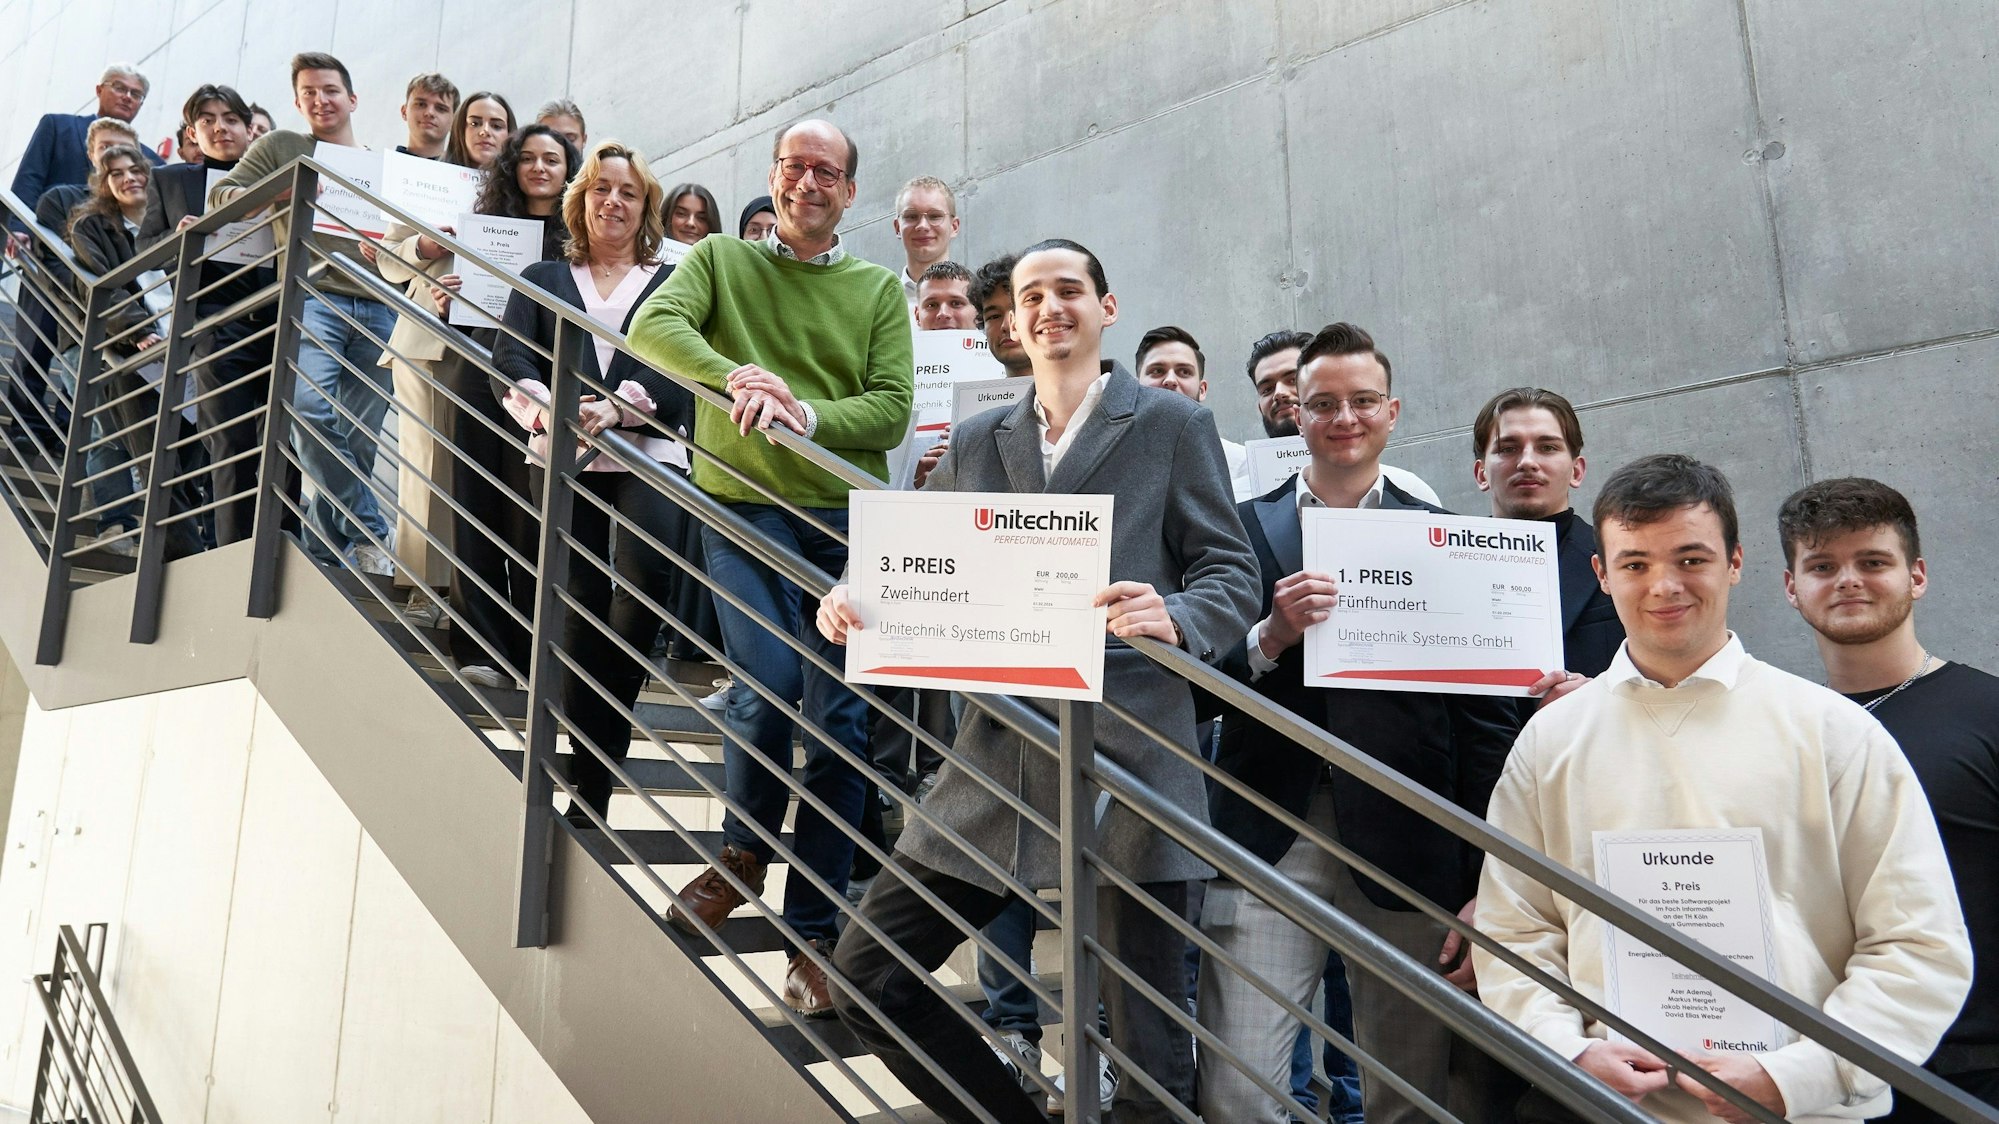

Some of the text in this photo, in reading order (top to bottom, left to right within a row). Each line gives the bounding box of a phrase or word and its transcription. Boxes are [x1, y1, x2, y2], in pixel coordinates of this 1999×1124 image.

[416, 181, 450, 194] PREIS
[482, 226, 519, 236] Urkunde
[916, 364, 950, 375] PREIS
[978, 392, 1015, 402] Urkunde
[914, 400, 943, 410] technik
[974, 508, 1100, 532] Unitechnik
[994, 535, 1100, 547] PERFECTION AUTOMATED.
[1428, 527, 1545, 552] Unitechnik
[1449, 551, 1497, 562] PERFECTION
[880, 556, 956, 575] 3. PREIS
[1338, 569, 1413, 586] 1. PREIS
[881, 586, 970, 603] Zweihundert
[1338, 595, 1428, 612] Fünfhundert
[880, 621, 1051, 643] Unitechnik Systems GmbH
[1338, 628, 1513, 648] Unitechnik Systems GmbH
[1643, 852, 1714, 865] Urkunde
[1662, 882, 1700, 891] 3. Preis
[1703, 1038, 1768, 1051] Unitechnik
